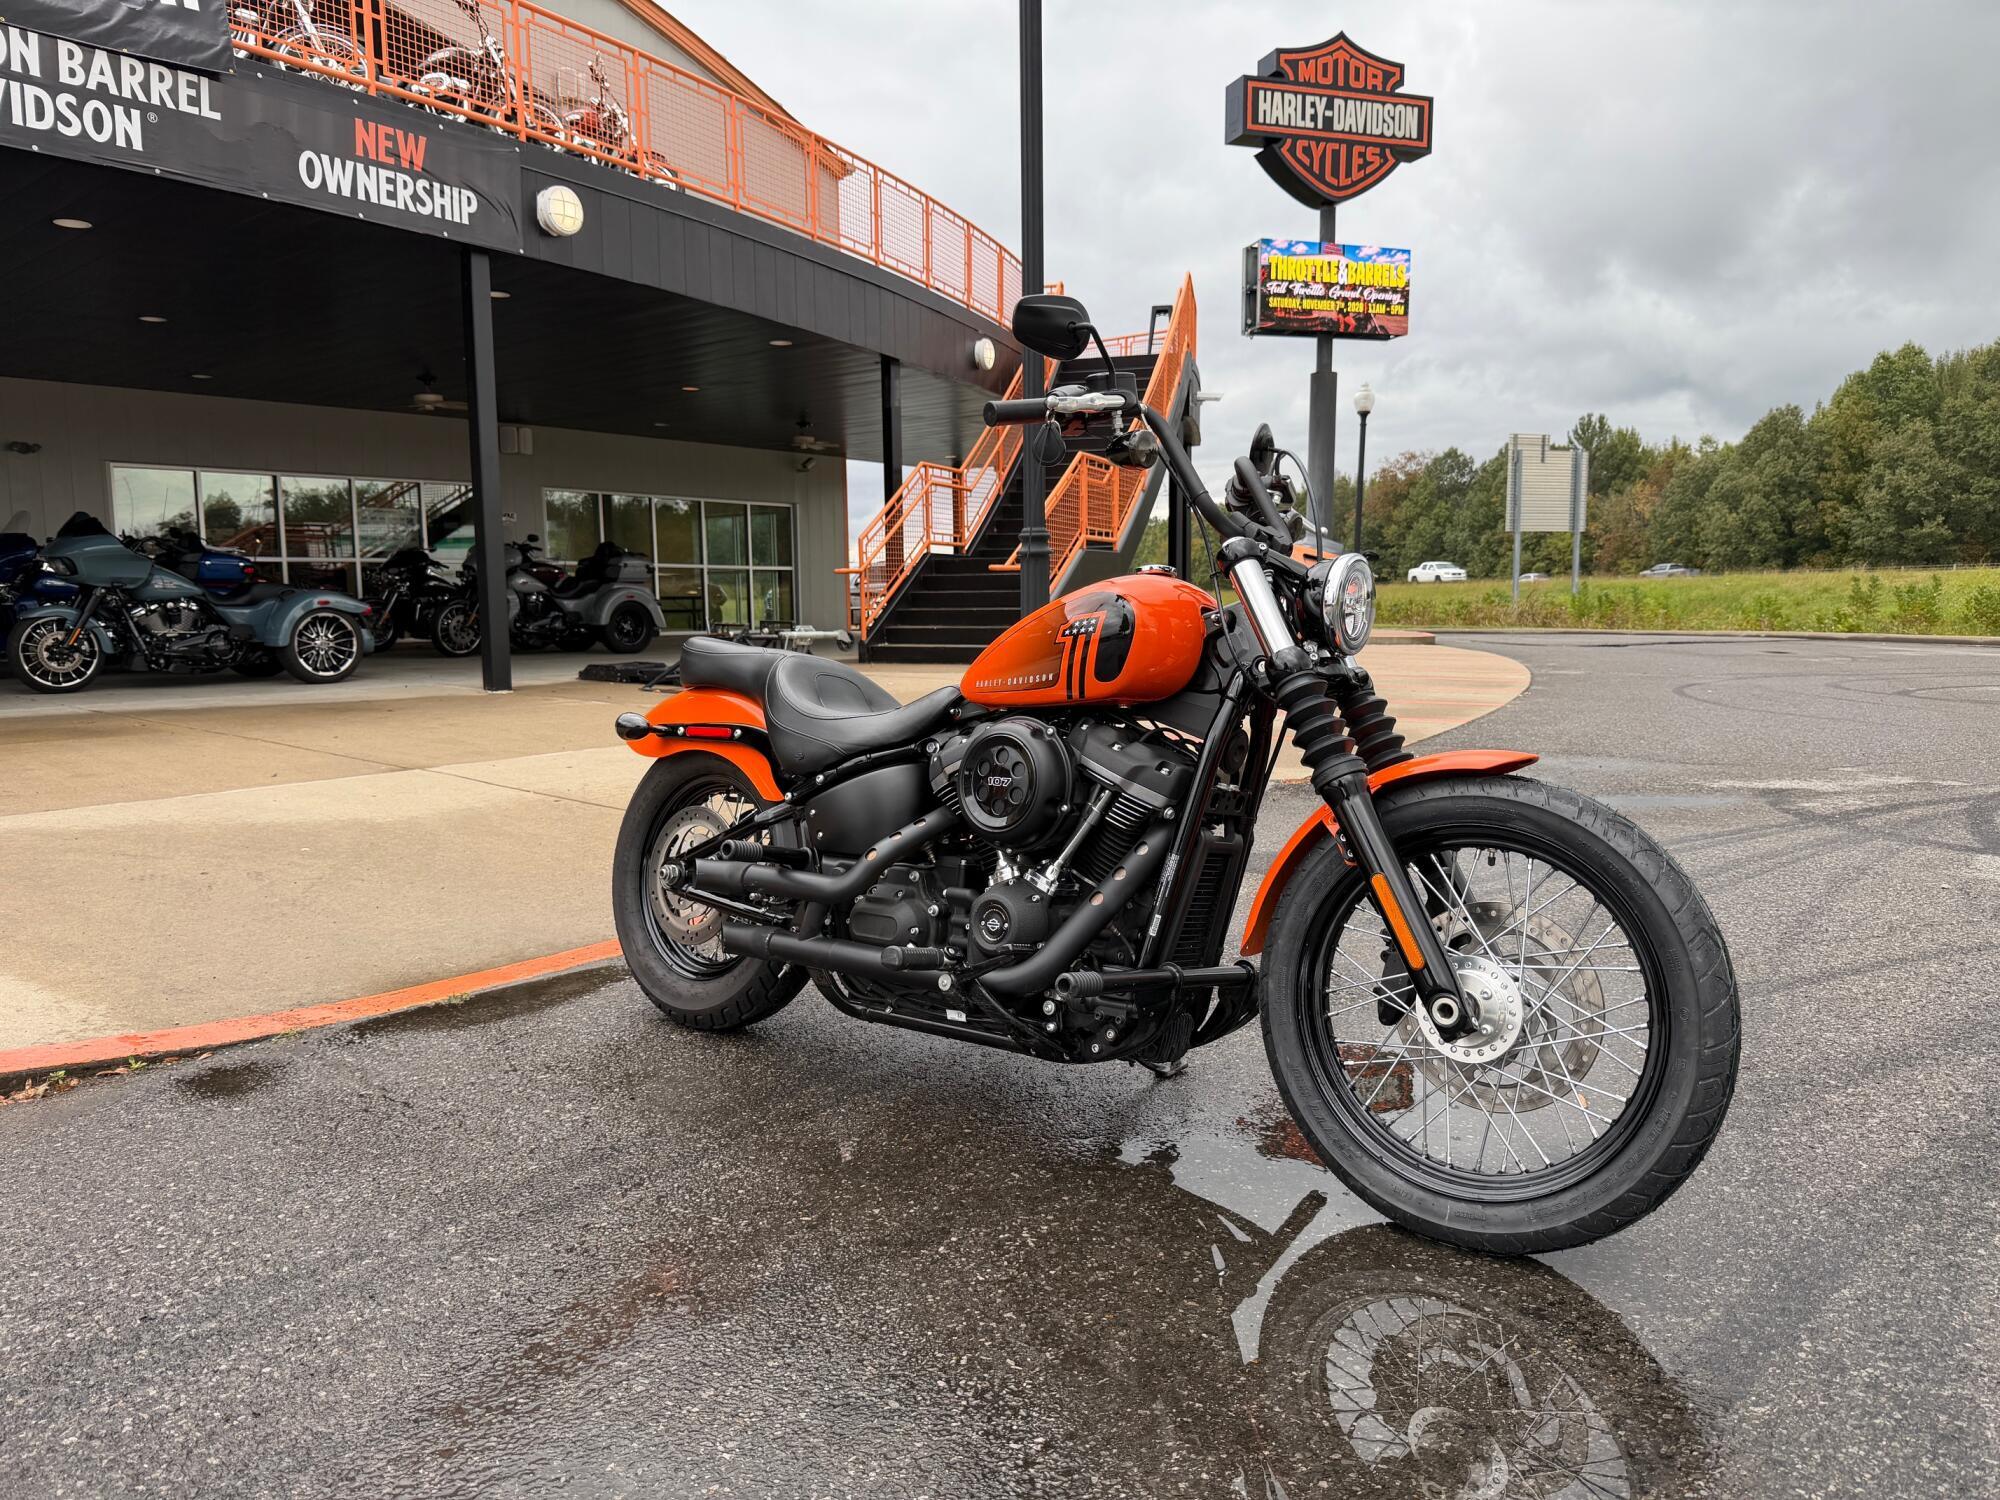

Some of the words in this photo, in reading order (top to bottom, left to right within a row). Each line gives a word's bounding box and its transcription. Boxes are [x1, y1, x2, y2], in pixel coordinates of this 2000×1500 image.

[57, 38, 222, 121] BARREL
[1298, 49, 1383, 92] MOTOR
[1258, 89, 1419, 139] HARLEY-DAVIDSON
[354, 117, 427, 172] NEW
[1296, 139, 1381, 187] CYCLES
[298, 150, 478, 225] OWNERSHIP
[1266, 281, 1286, 295] Full
[1289, 282, 1325, 297] Throttle
[1329, 286, 1361, 300] Grand
[1268, 255, 1338, 284] THROTTLE
[1347, 260, 1406, 288] BARRELS
[1303, 299, 1334, 311] NOVEMBER
[1368, 302, 1386, 314] 11AM
[1391, 304, 1405, 315] 5PM
[975, 673, 1054, 688] HARLEY-DAVIDSON
[987, 776, 1012, 787] 107
